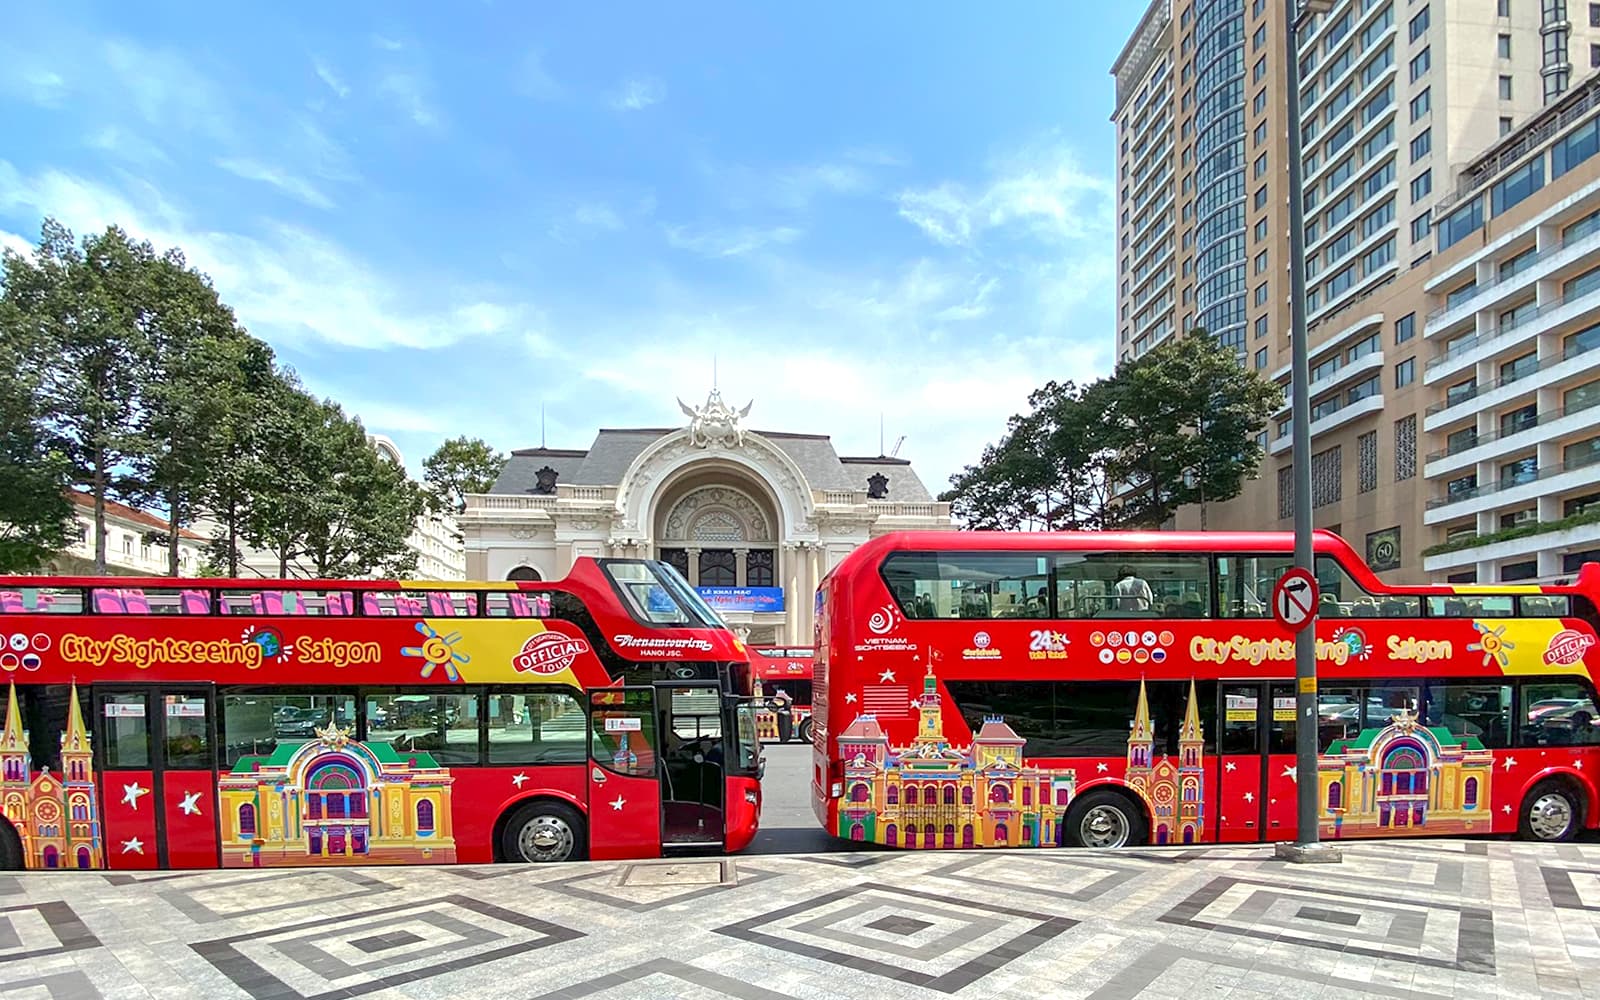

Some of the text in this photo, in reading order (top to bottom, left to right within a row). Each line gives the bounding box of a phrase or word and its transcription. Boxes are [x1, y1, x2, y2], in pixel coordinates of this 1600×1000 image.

[1377, 543, 1393, 559] 60
[295, 635, 381, 668] Saigon
[520, 641, 584, 668] OFFICIAL
[613, 634, 713, 651] Vietnamtourism
[1387, 635, 1452, 663] Saigon
[1547, 636, 1593, 662] OFFICIAL
[542, 657, 570, 672] TOUR
